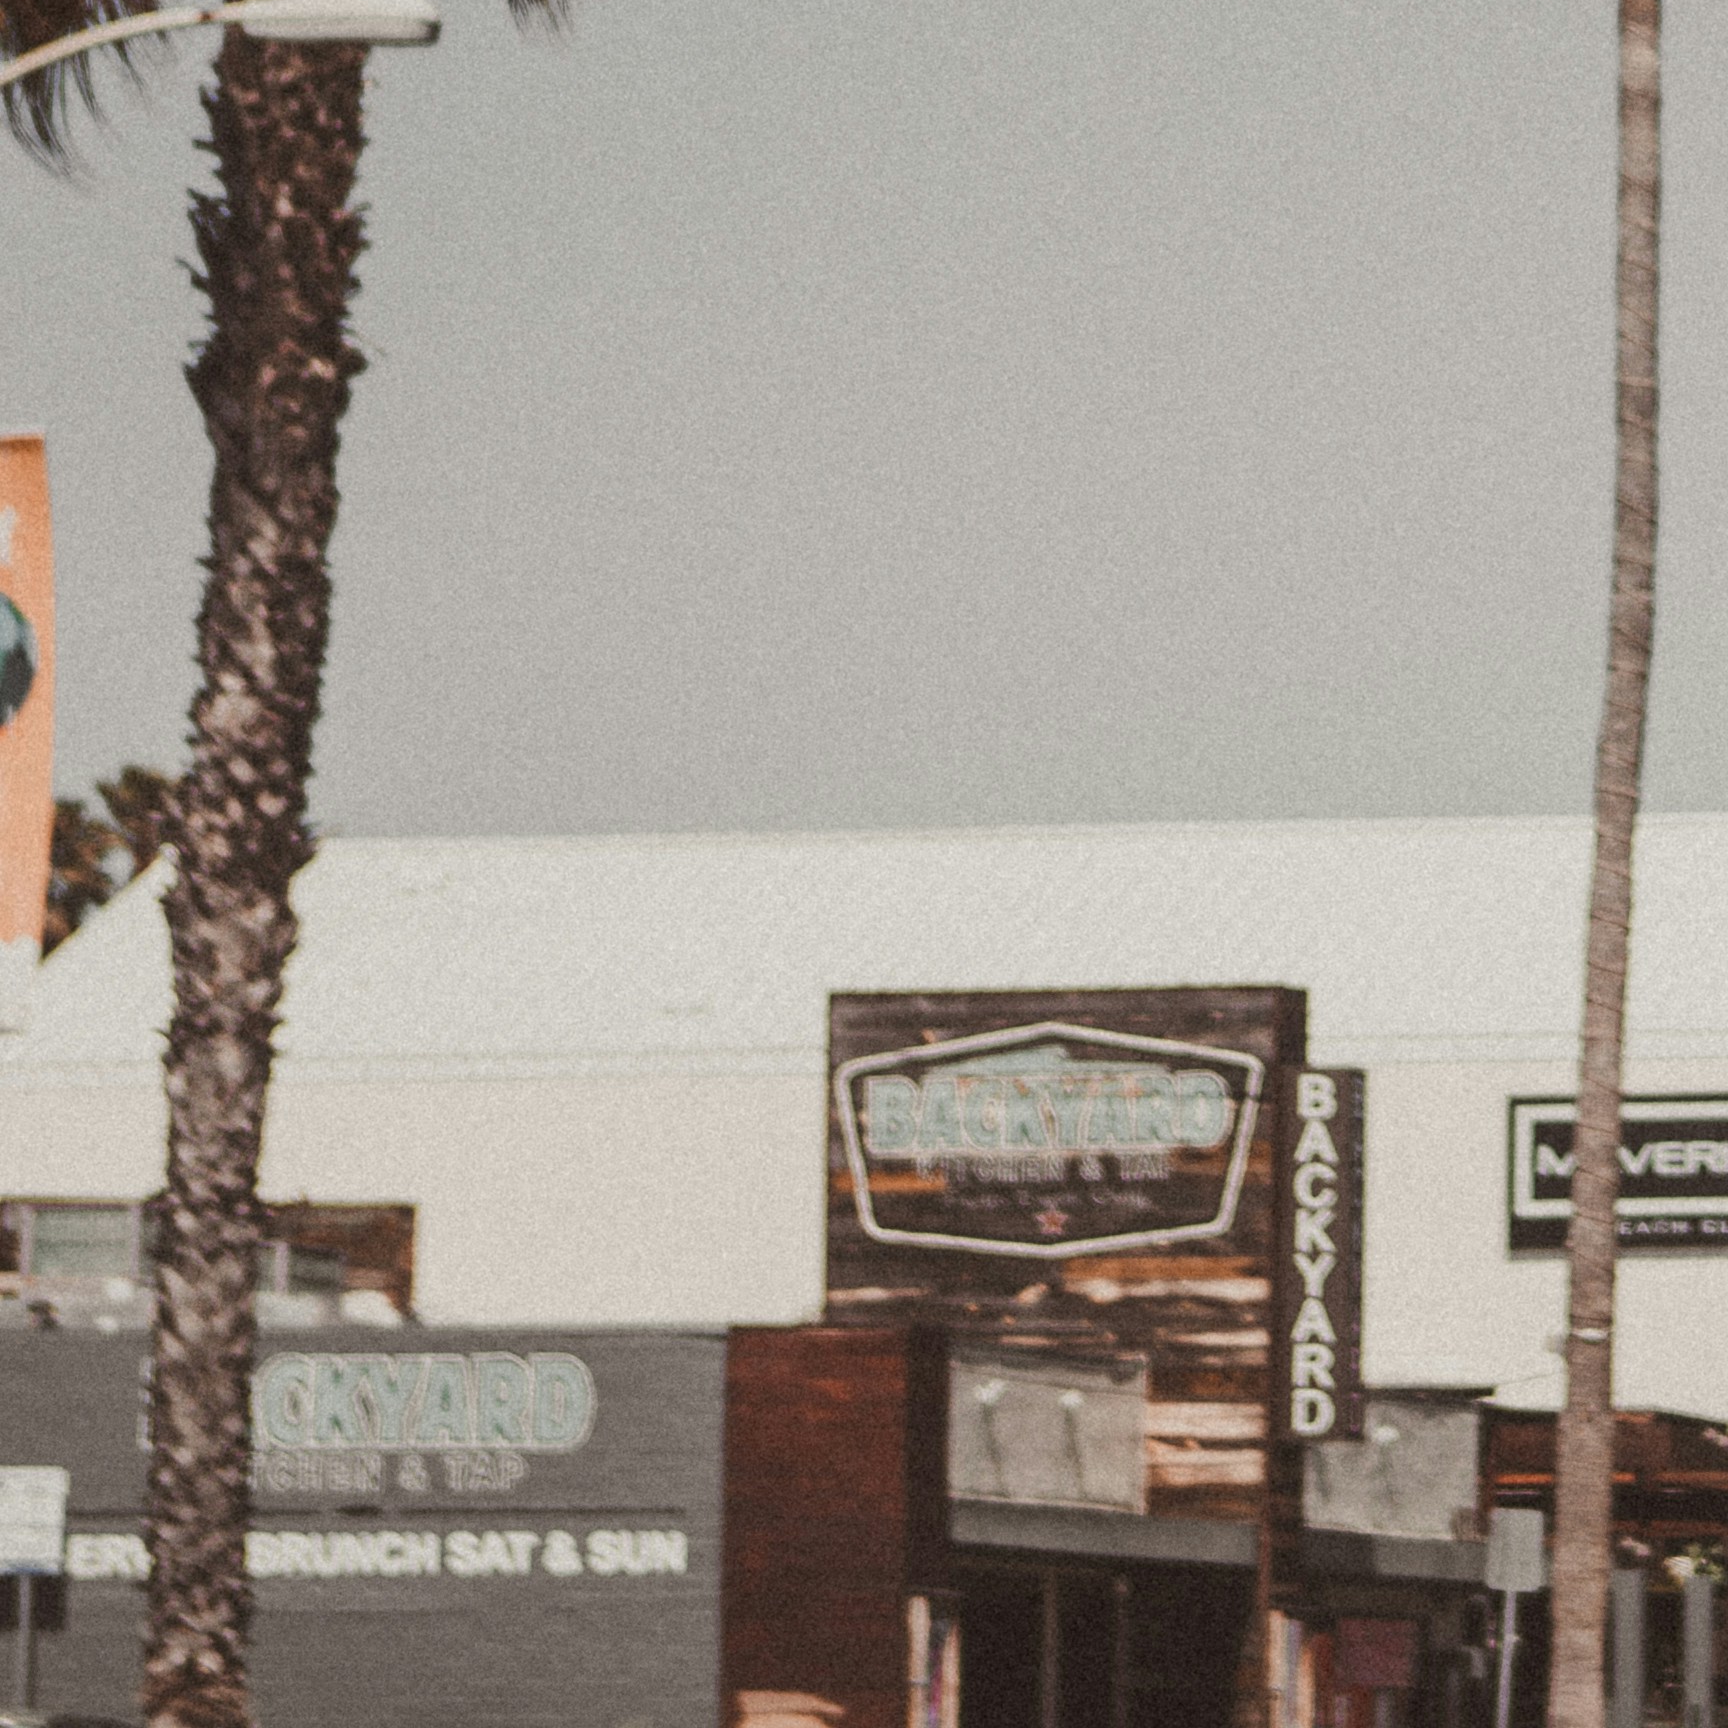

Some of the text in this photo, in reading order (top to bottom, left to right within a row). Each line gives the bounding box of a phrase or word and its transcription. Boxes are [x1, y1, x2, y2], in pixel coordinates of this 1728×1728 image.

[864, 1068, 1235, 1155] BACKYARD
[1291, 1072, 1339, 1434] BACKYARD
[1618, 1219, 1691, 1236] EACH
[137, 1352, 597, 1453] CKYARD
[443, 1451, 530, 1492] TAP
[244, 1529, 688, 1577] BRUNCH SAT & SUN
